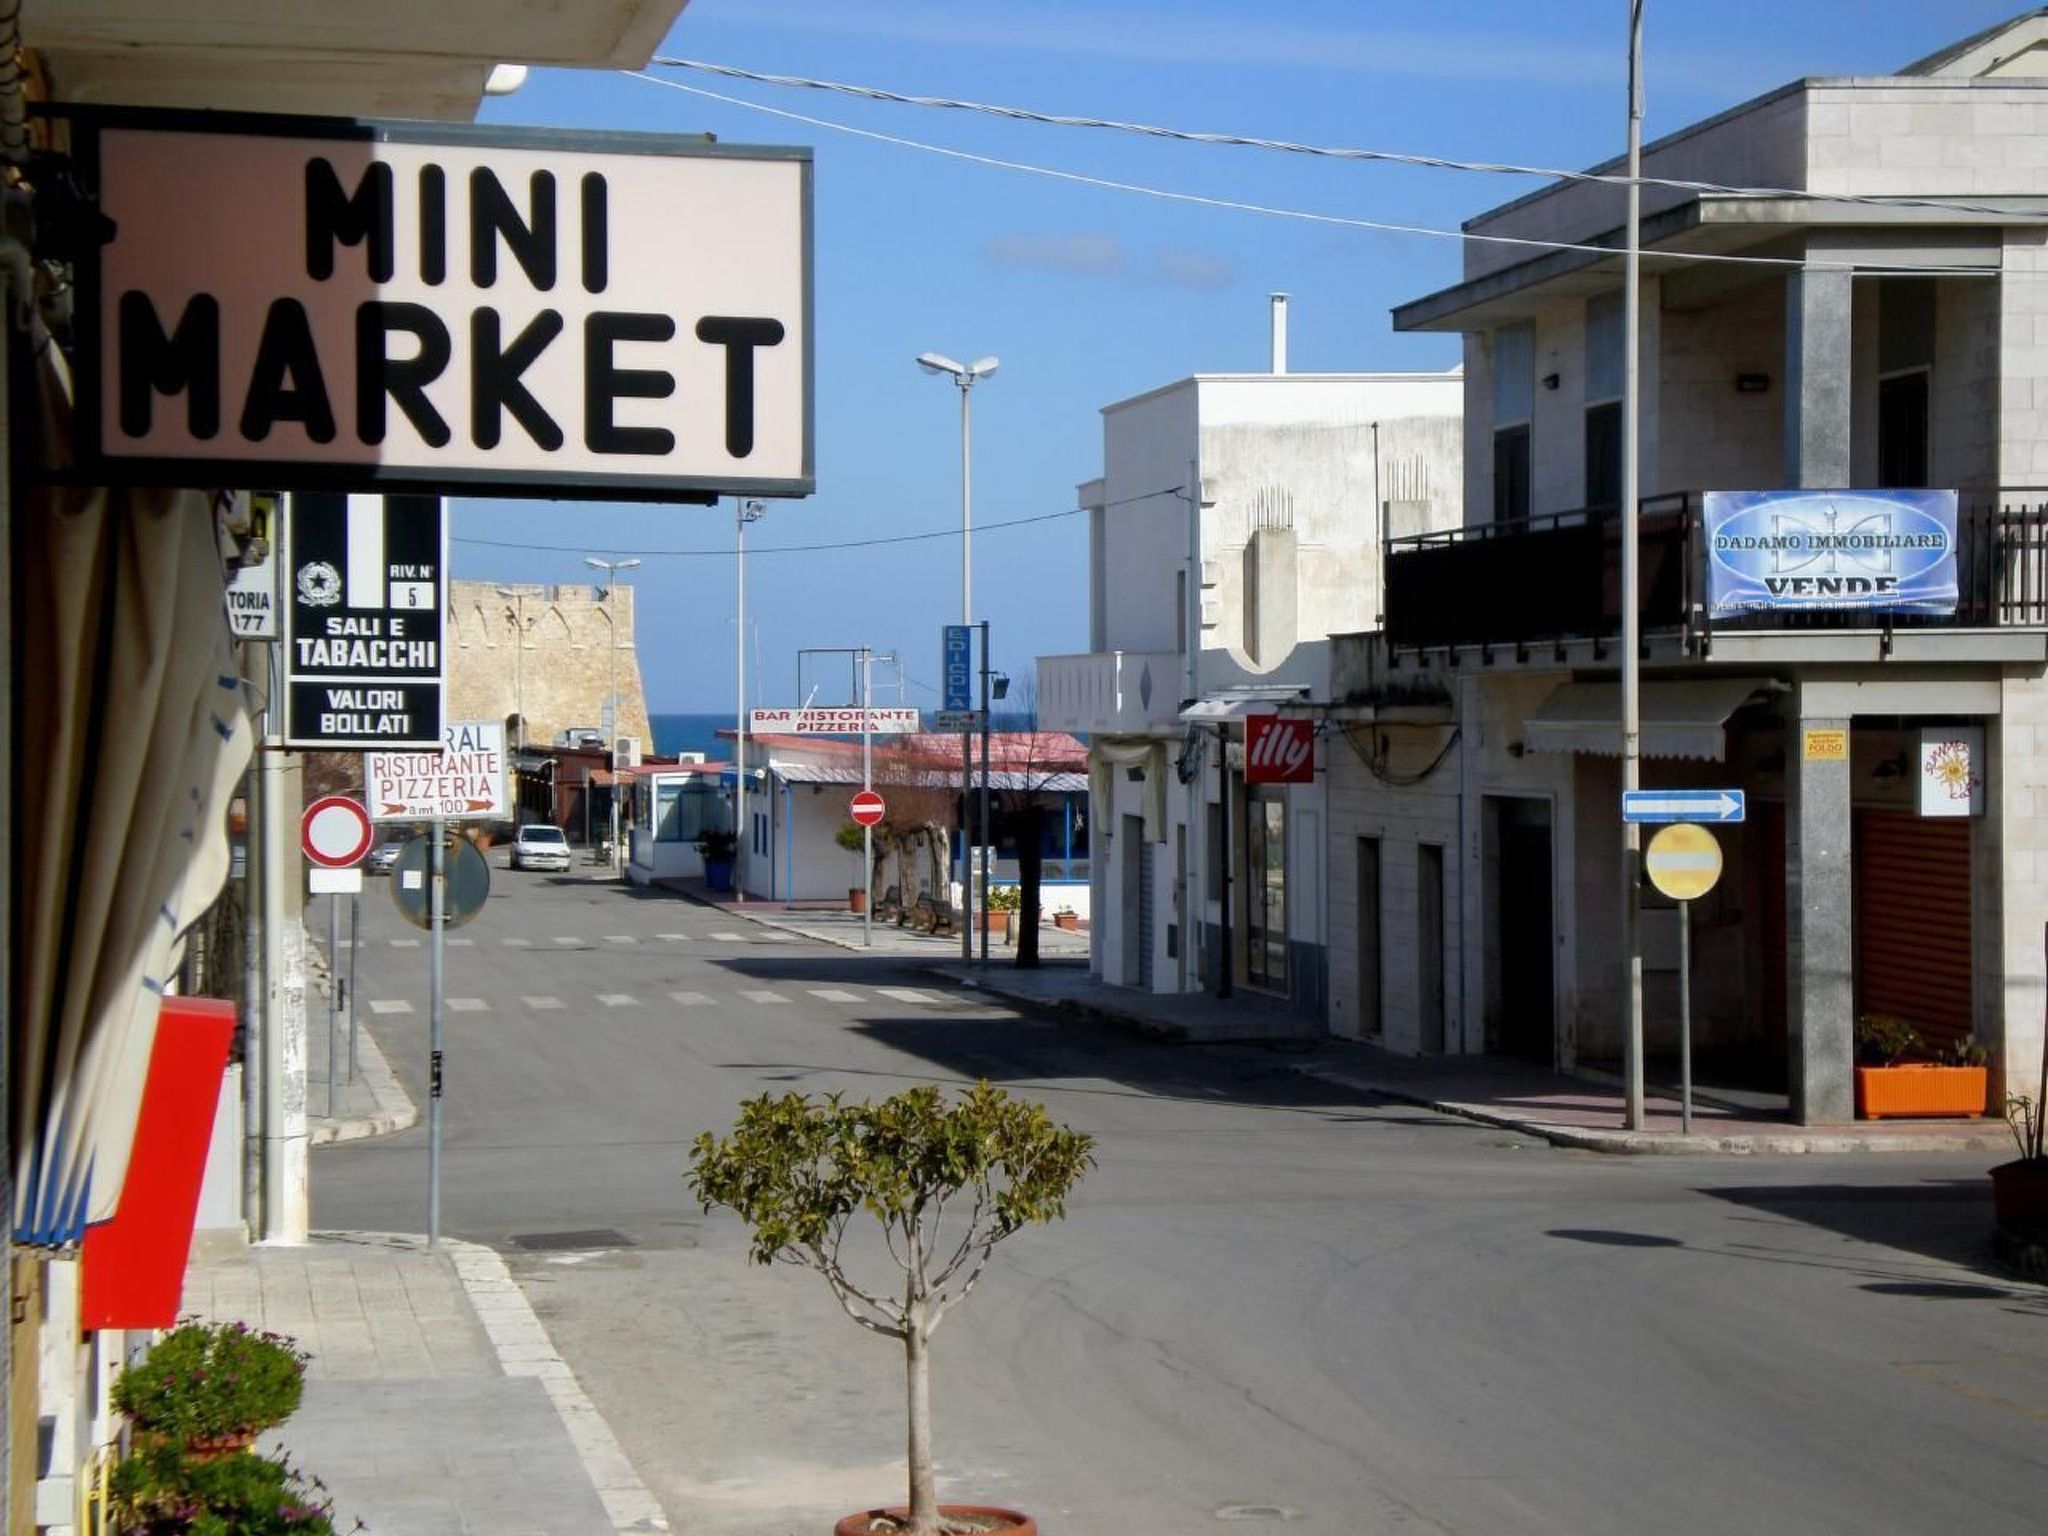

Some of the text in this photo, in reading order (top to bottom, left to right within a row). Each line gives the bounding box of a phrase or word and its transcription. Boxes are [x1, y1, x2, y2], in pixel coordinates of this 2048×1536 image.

[305, 156, 609, 294] MINI
[118, 288, 785, 460] MARKET
[1807, 533, 1944, 550] IMMOBILIARE
[389, 565, 417, 578] RIV.
[408, 587, 417, 607] 5
[1764, 576, 1899, 597] VENDE
[326, 617, 405, 636] SALI E
[296, 638, 437, 668] TABACCHI
[948, 628, 967, 708] EDICOLA
[326, 689, 404, 710] VALORI
[320, 713, 409, 734] BOLLATI
[755, 711, 915, 721] BAR RISTORANTE
[797, 722, 880, 732] PIZZERIA
[1251, 722, 1310, 778] illy
[372, 752, 499, 779] RISTORANTE
[381, 776, 492, 801] PIZZERIA
[440, 799, 463, 814] 100
